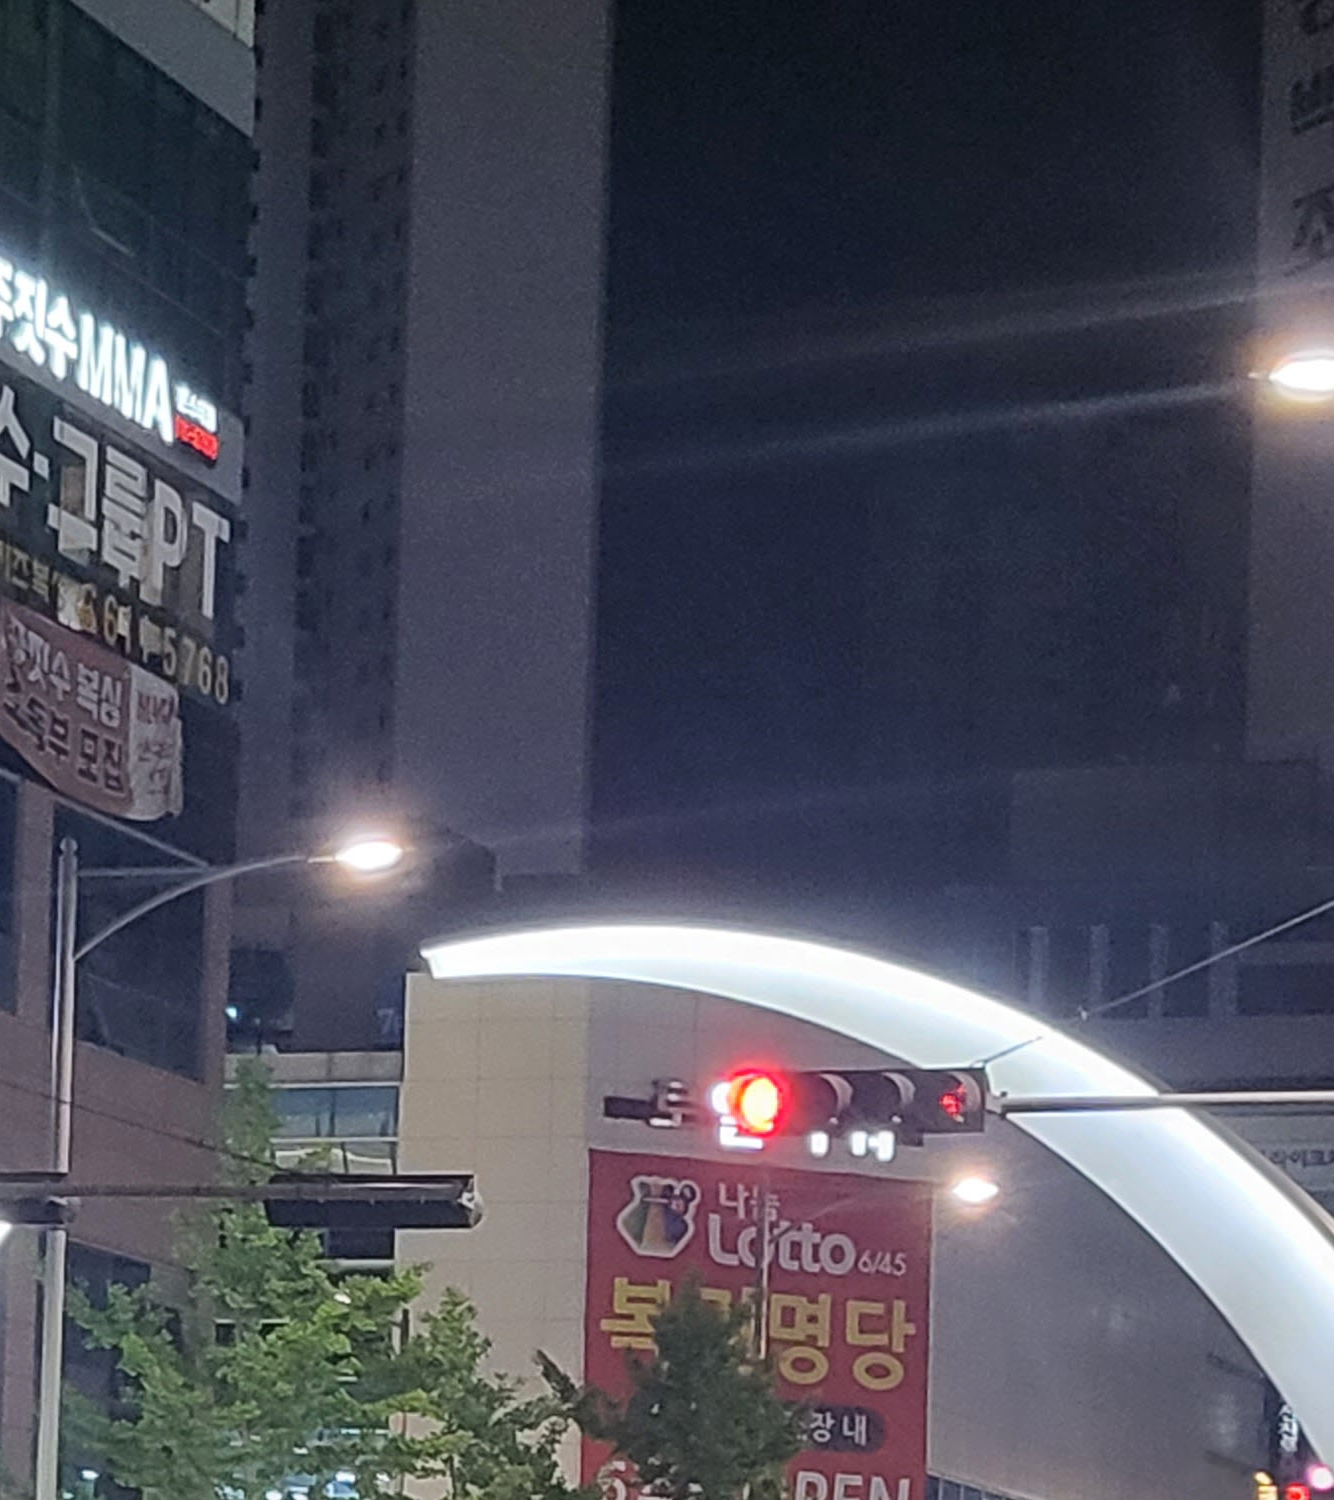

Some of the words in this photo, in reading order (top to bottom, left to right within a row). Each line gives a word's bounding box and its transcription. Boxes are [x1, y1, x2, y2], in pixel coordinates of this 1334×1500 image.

[708, 1211, 856, 1276] Lotto
[857, 1249, 908, 1278] 6/45
[599, 1276, 917, 1393] 복명당
